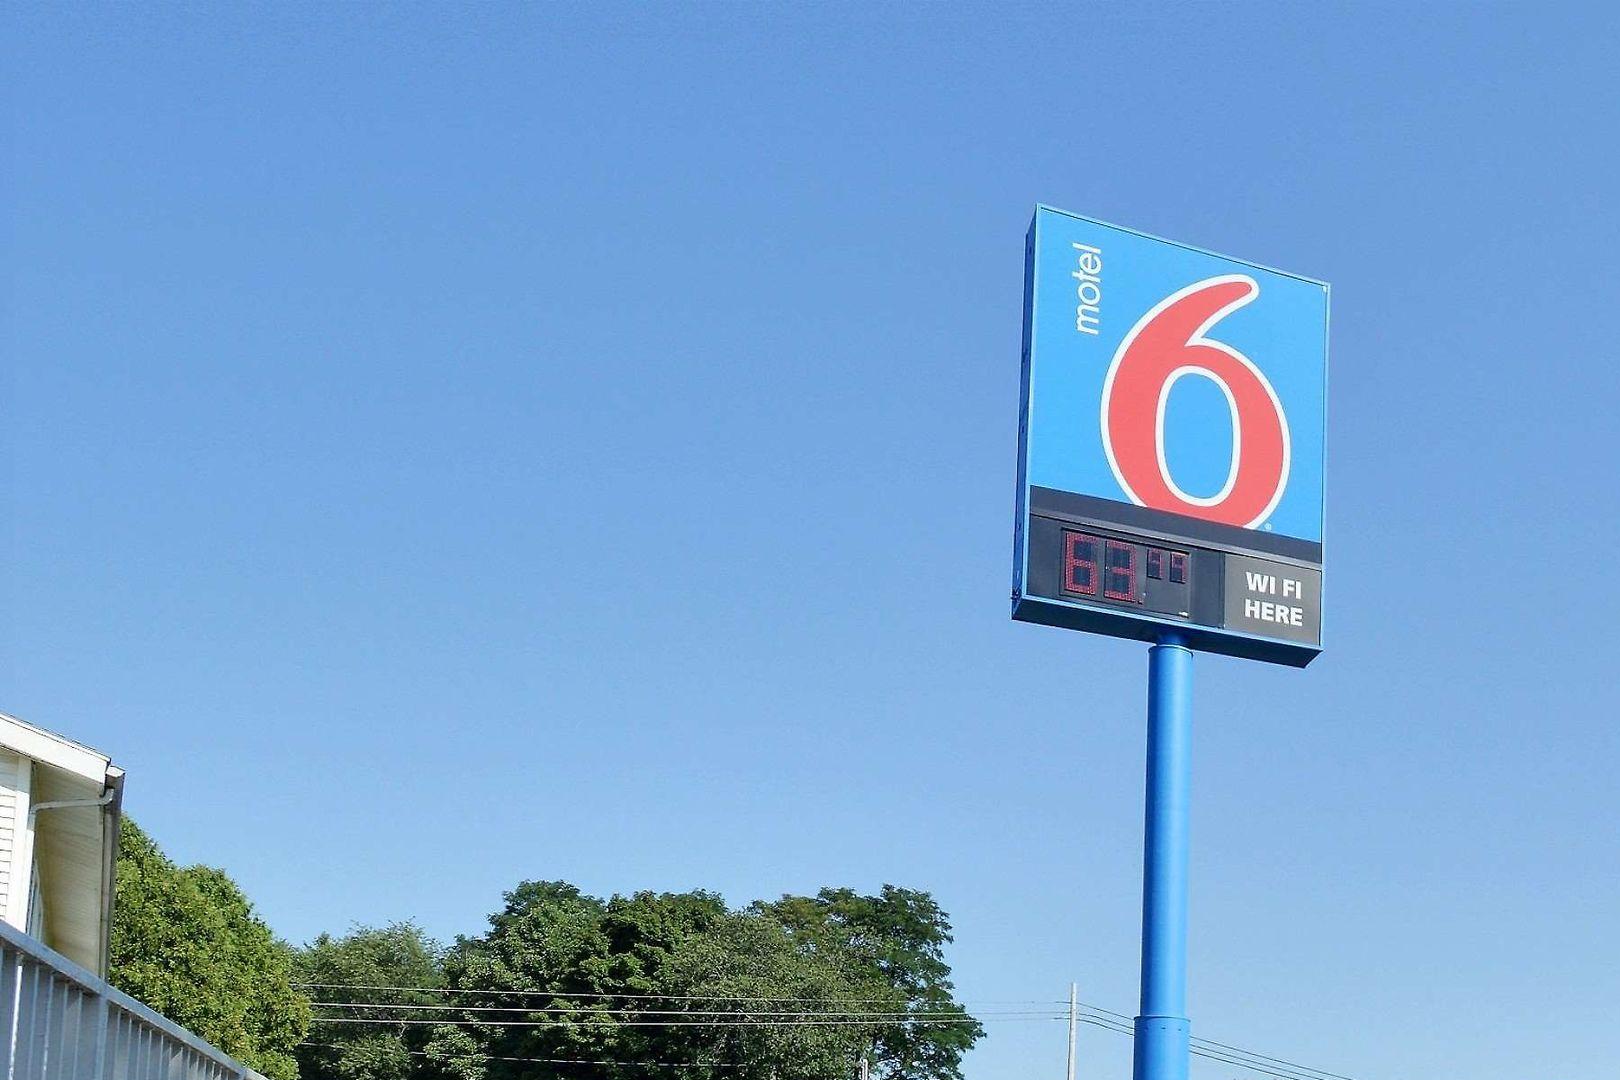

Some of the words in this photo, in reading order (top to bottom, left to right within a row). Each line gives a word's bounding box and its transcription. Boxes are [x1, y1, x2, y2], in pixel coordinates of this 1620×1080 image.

[1072, 243, 1102, 335] motel
[1100, 274, 1291, 529] 6
[1245, 599, 1302, 626] HERE
[1246, 572, 1275, 594] WI
[1283, 579, 1301, 599] FI
